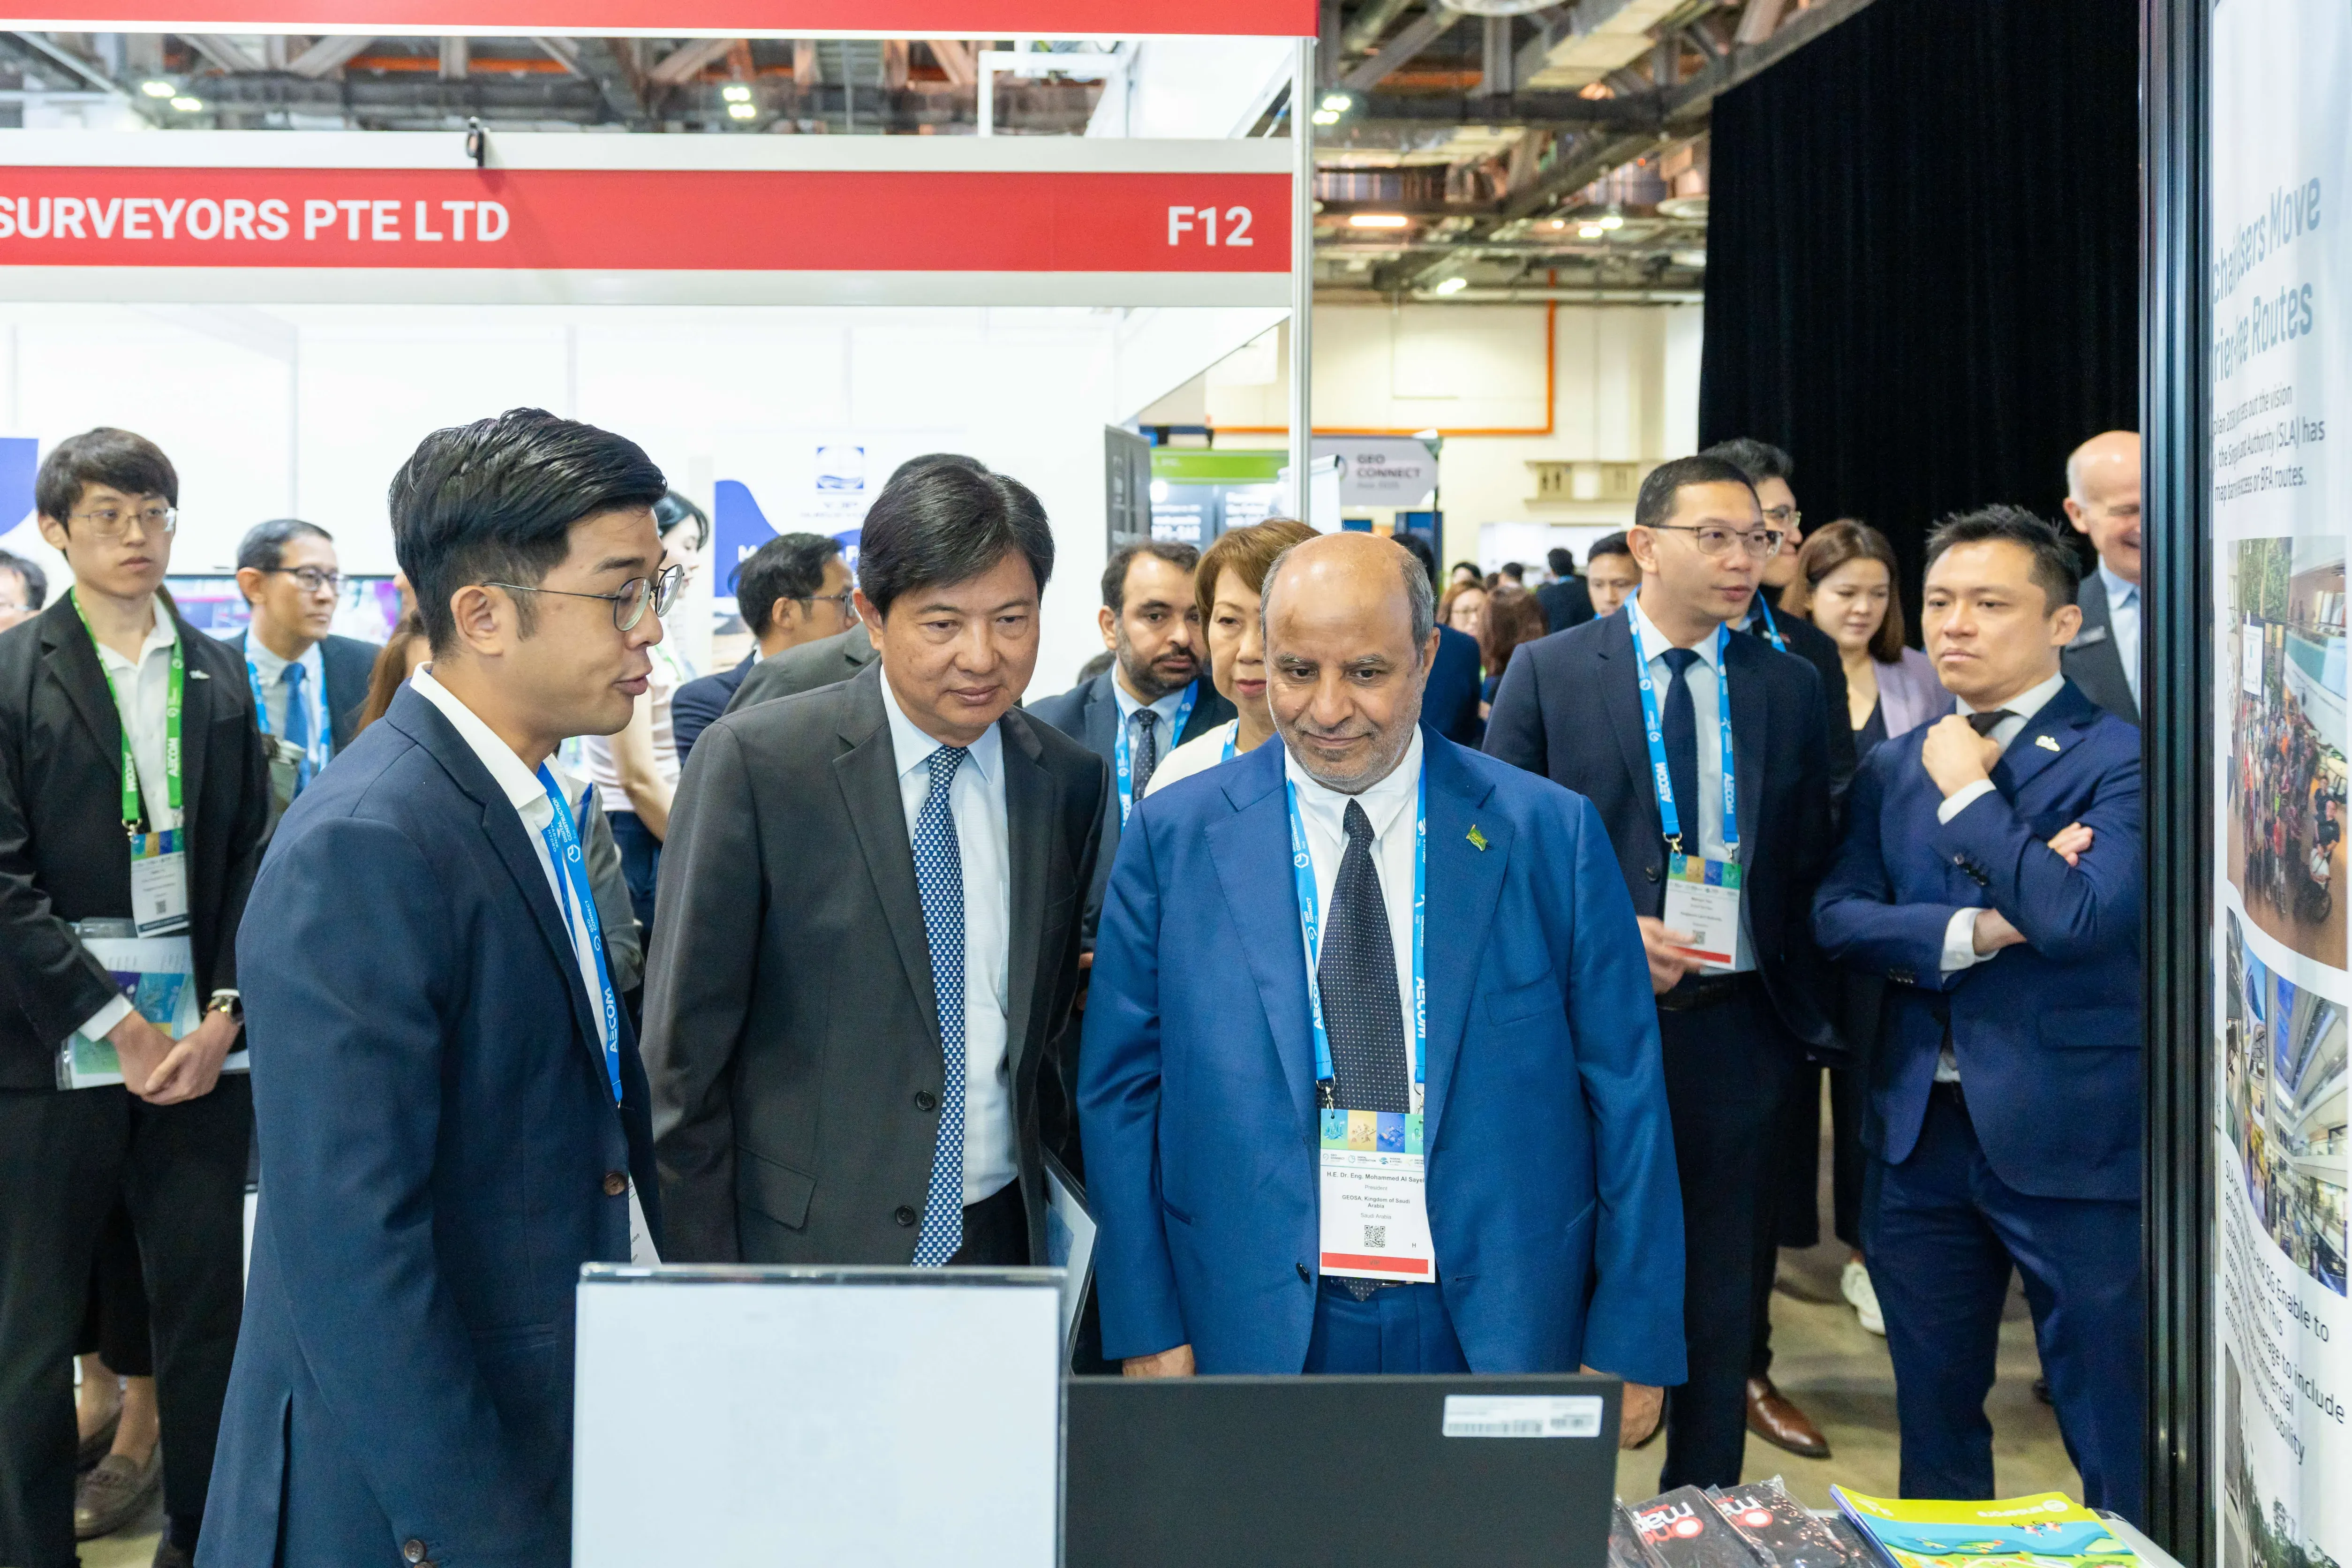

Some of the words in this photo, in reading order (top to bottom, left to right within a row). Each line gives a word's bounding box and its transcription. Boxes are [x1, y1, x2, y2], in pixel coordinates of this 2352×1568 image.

[0, 197, 290, 241] SURVEYORS
[304, 200, 401, 241] PTE
[415, 202, 510, 241] LTD
[1168, 206, 1254, 246] F12
[2237, 214, 2266, 281] sers
[2270, 177, 2321, 254] Move
[2252, 282, 2313, 357] Routes
[2259, 389, 2269, 414] the
[2270, 382, 2292, 410] vision
[1357, 453, 1385, 464] GEO
[2219, 445, 2227, 468] the
[2248, 425, 2275, 457] Authority
[2277, 416, 2300, 453] (SLA)
[2303, 415, 2325, 443] has
[1357, 467, 1420, 478] CONNECT
[2215, 484, 2227, 507] map
[2261, 466, 2273, 491] BFA
[2275, 464, 2307, 489] routes.
[167, 737, 179, 777] AECOM
[1655, 762, 1673, 803] AECOM
[1724, 772, 1735, 814] AECOM
[551, 797, 572, 841] CONSTRUCTION
[1122, 794, 1131, 827] COM
[547, 829, 557, 852] HYDRO
[550, 822, 559, 848] MARINE
[558, 820, 568, 843] DIGITAL
[1290, 814, 1301, 851] CONSTRUCTION
[585, 900, 597, 931] CONNECT
[604, 987, 618, 1053] AECOM
[1416, 976, 1425, 1038] AECOM
[2267, 1264, 2275, 1293] SG
[2277, 1278, 2311, 1329] Enable
[2314, 1315, 2329, 1342] to
[2268, 1298, 2283, 1336] This
[2256, 1346, 2294, 1416] commercial
[2282, 1353, 2292, 1379] to
[2294, 1364, 2345, 1425] include
[2269, 1403, 2305, 1465] mobility
